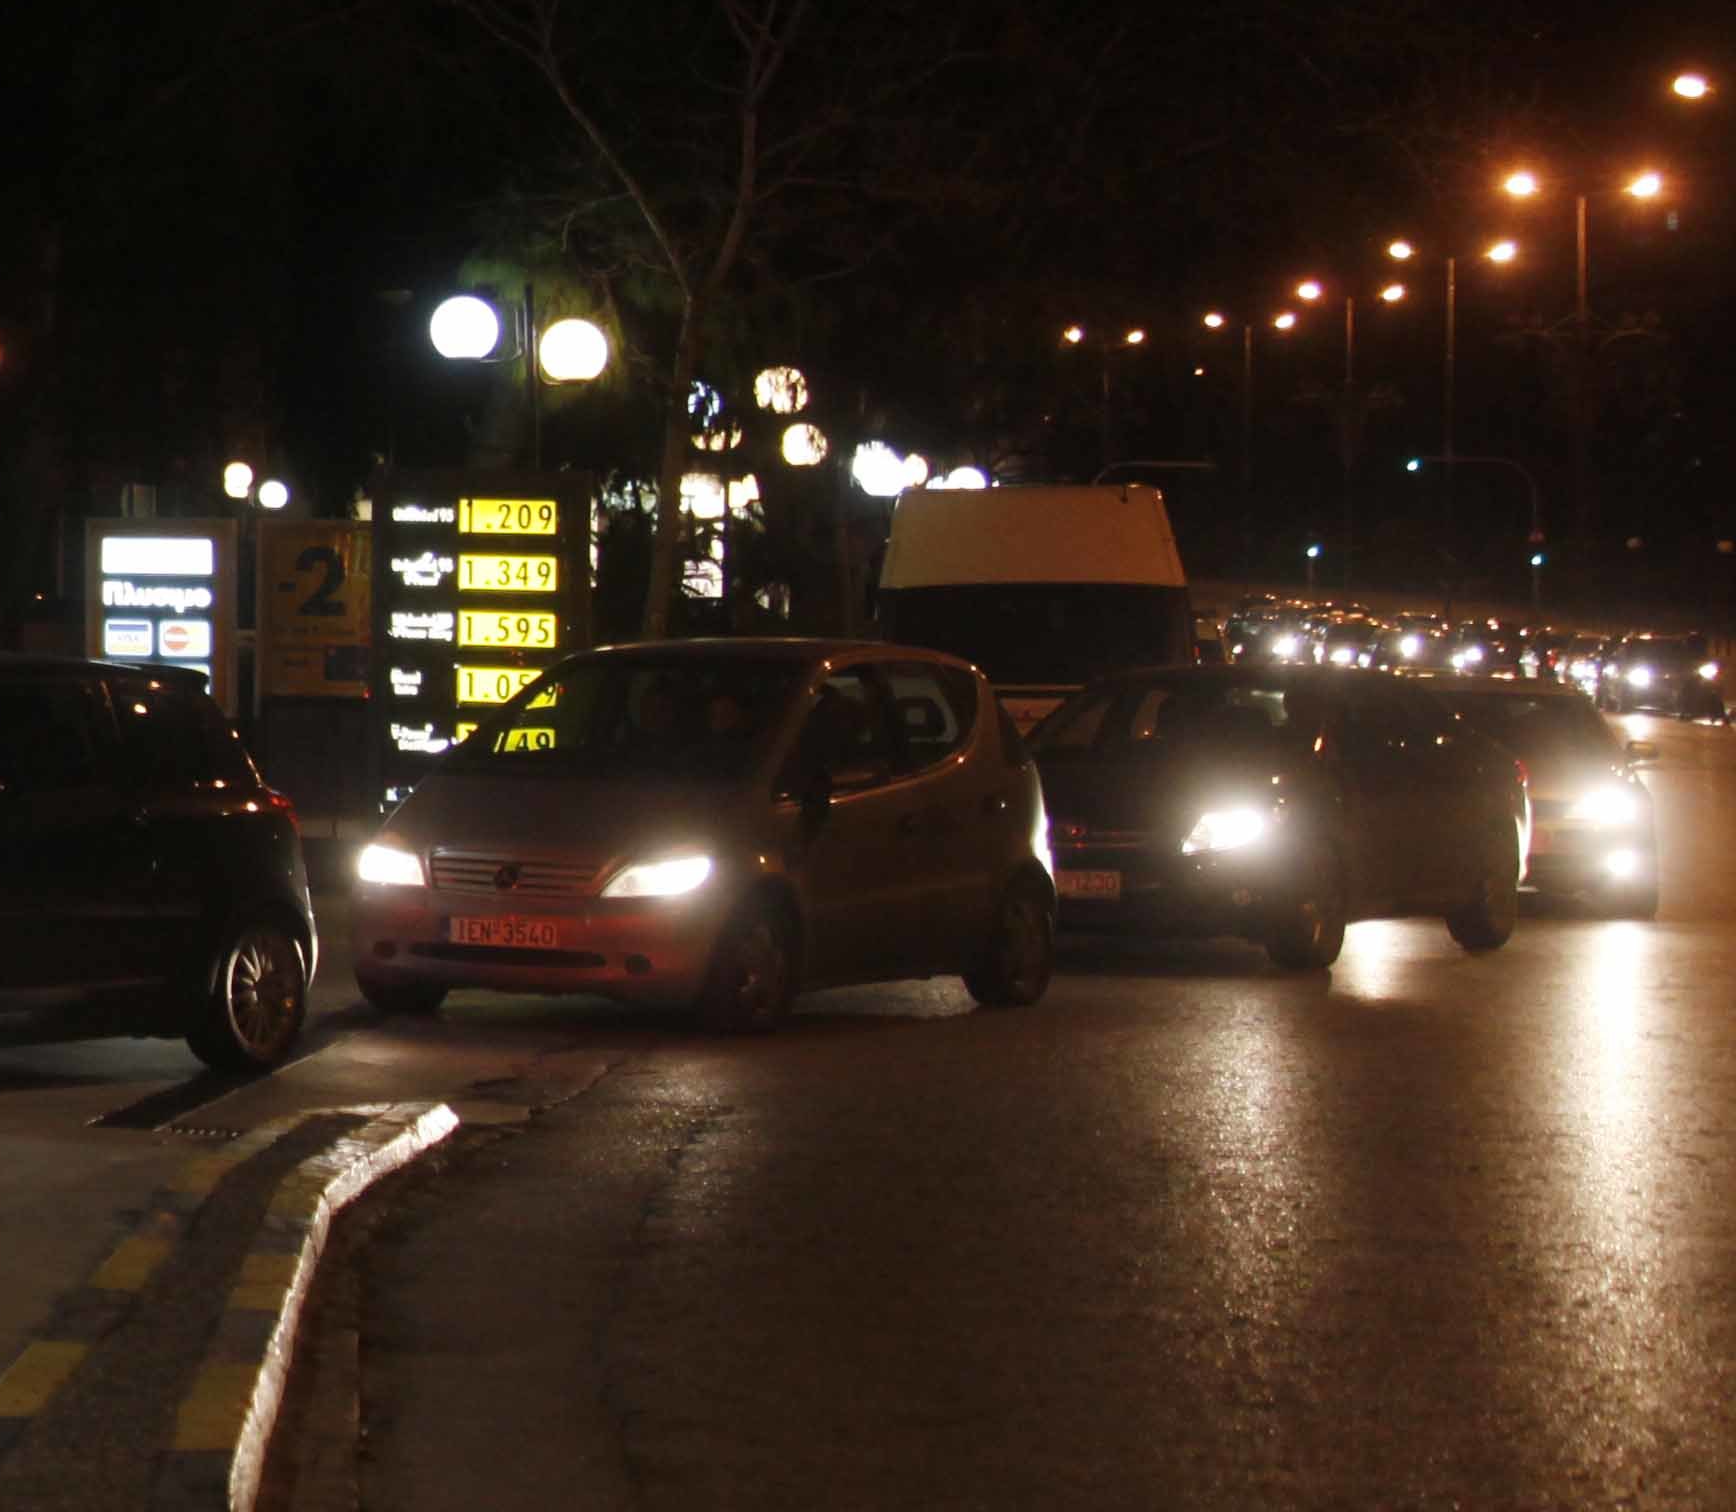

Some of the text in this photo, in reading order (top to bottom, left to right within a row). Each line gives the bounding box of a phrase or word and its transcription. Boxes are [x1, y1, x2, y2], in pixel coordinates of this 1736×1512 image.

[465, 503, 552, 530] 1.209
[465, 559, 551, 586] 1.349
[465, 615, 550, 644] 1.595
